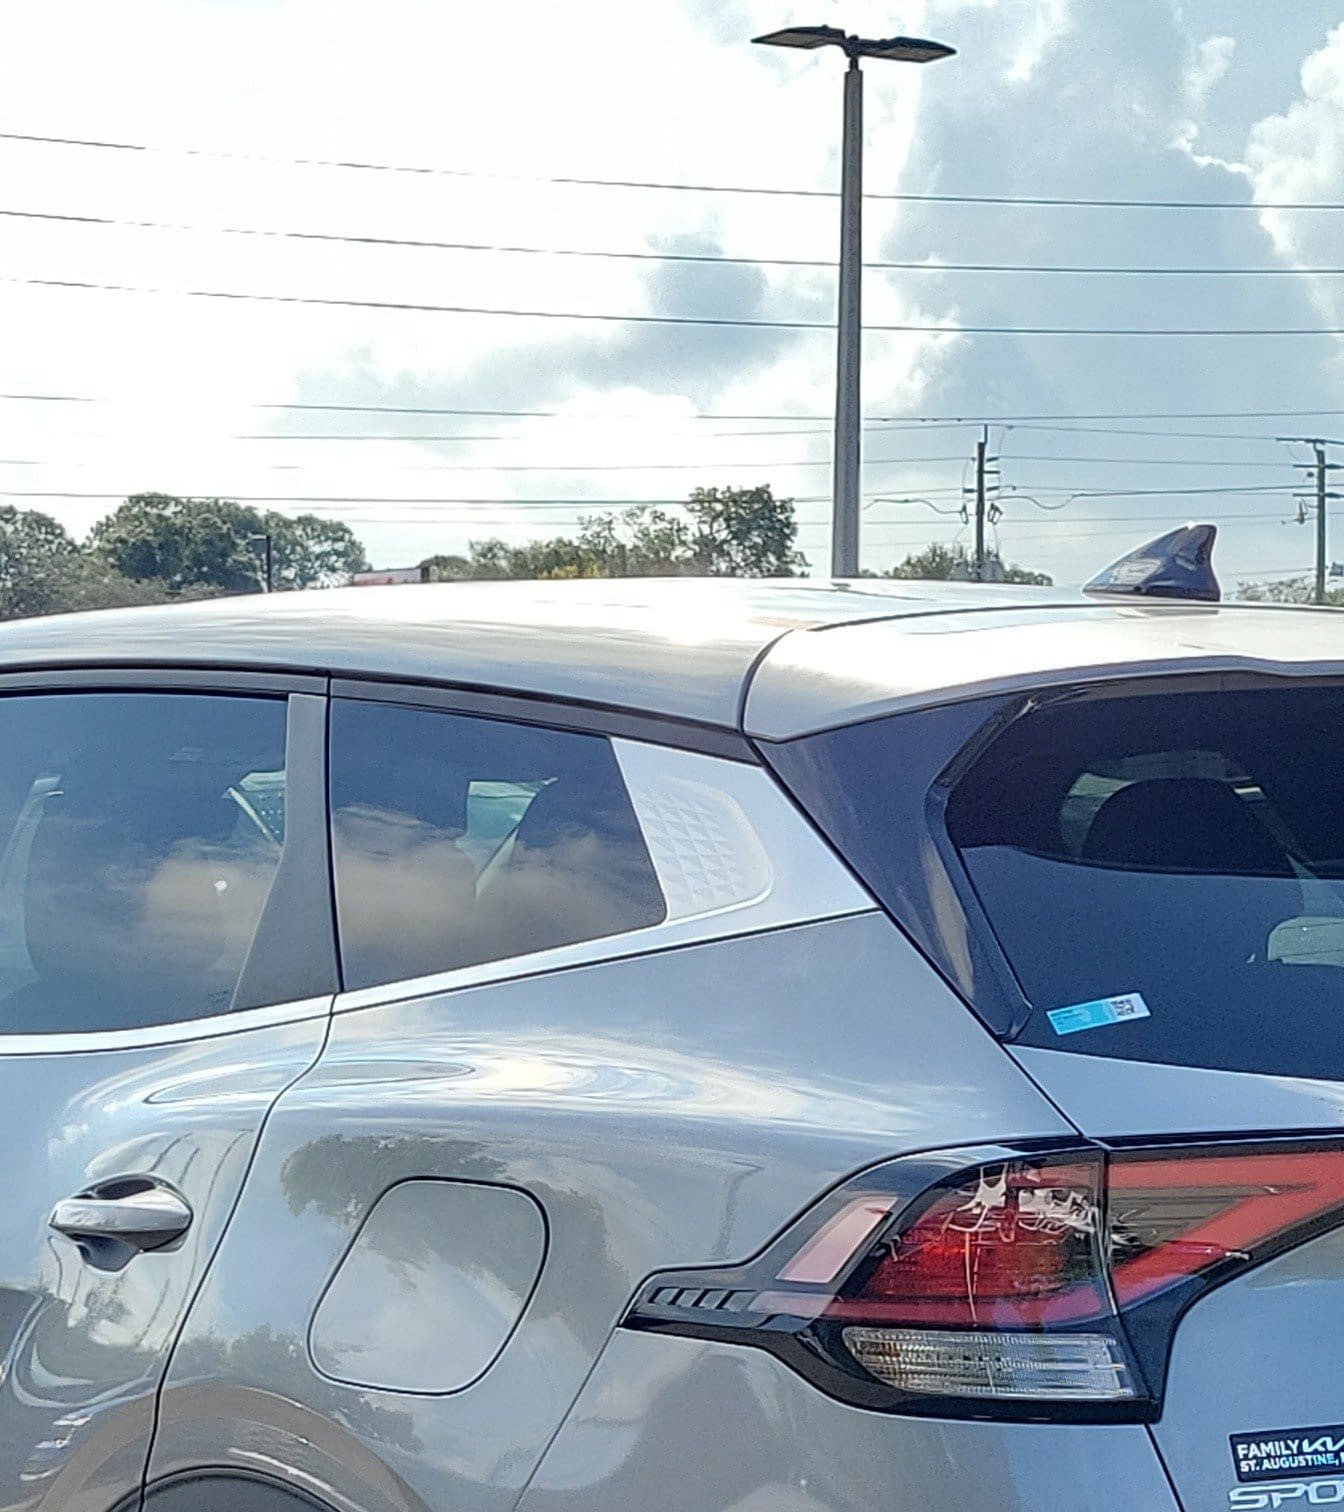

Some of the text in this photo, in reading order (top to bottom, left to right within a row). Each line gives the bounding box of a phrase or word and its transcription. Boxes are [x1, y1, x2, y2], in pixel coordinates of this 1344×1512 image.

[1236, 1439, 1299, 1459] FAMILY
[1240, 1459, 1260, 1473] ST.
[1262, 1453, 1339, 1471] AUGUSTINE,
